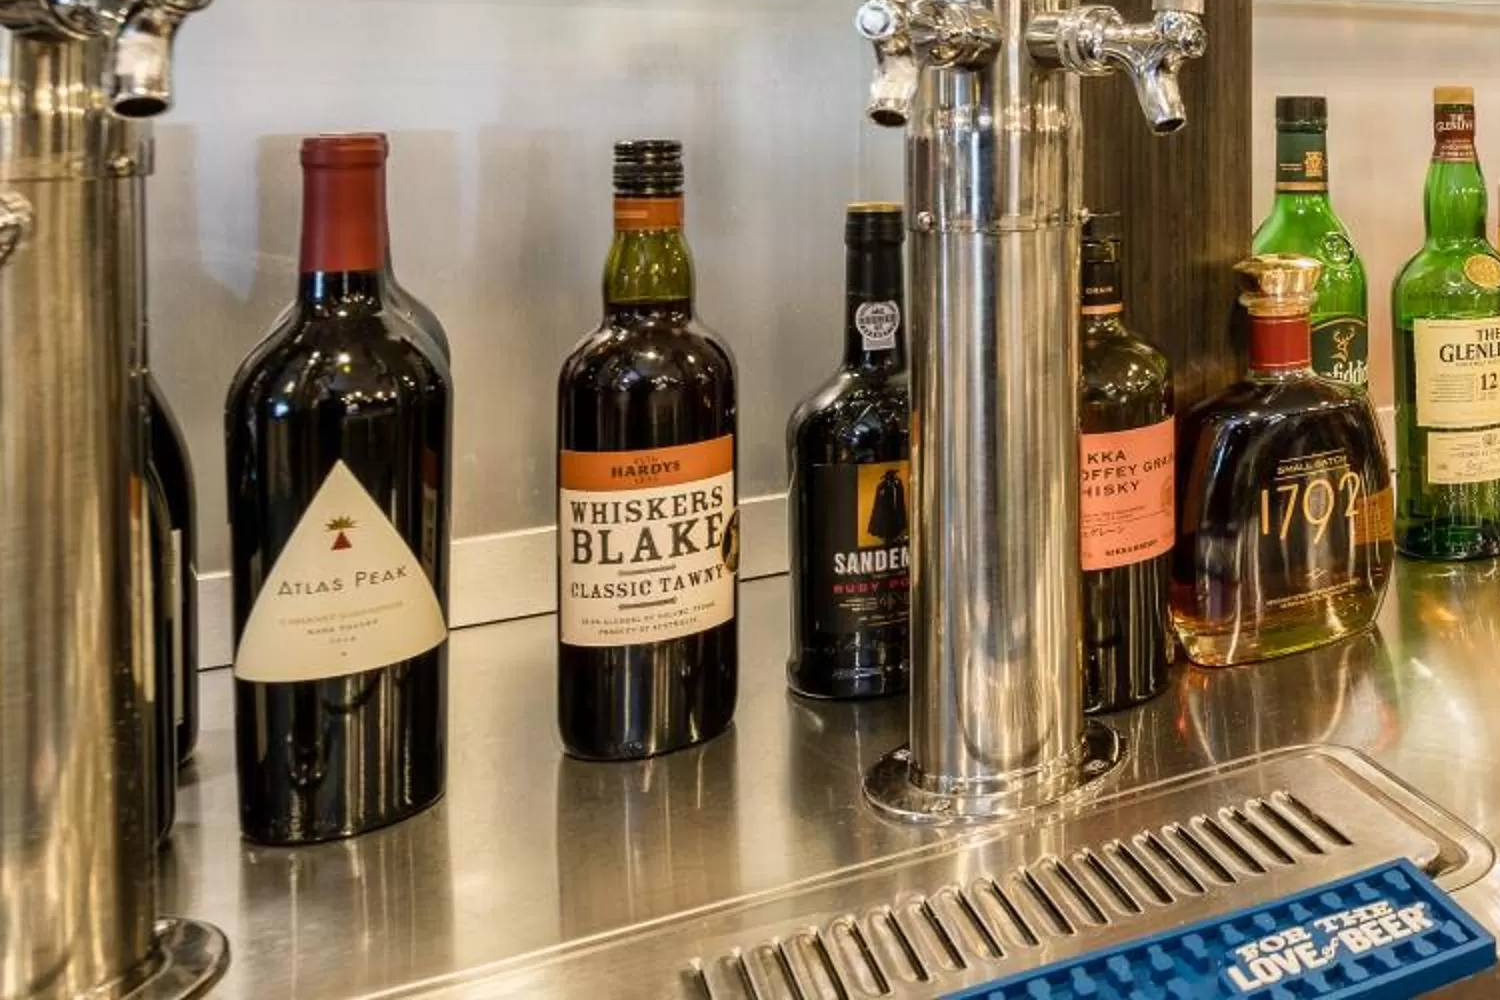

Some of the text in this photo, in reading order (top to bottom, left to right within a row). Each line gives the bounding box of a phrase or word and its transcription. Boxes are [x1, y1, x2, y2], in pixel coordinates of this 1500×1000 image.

[1475, 327, 1500, 341] THE
[1480, 372, 1498, 391] 12
[611, 460, 681, 479] HARDYS
[1080, 463, 1138, 480] OFFEY
[1087, 450, 1127, 465] KKA
[570, 485, 723, 524] WHISKERS
[1083, 480, 1139, 498] HISKY
[1261, 471, 1362, 546] 1792
[571, 511, 724, 566] BLAKE
[278, 565, 408, 596] ATLAS PEAK
[570, 562, 727, 600] CLASSIC TAWNY
[1227, 941, 1328, 992] LOVE
[1337, 902, 1435, 954] BEER
[1235, 900, 1394, 963] FOR THE
